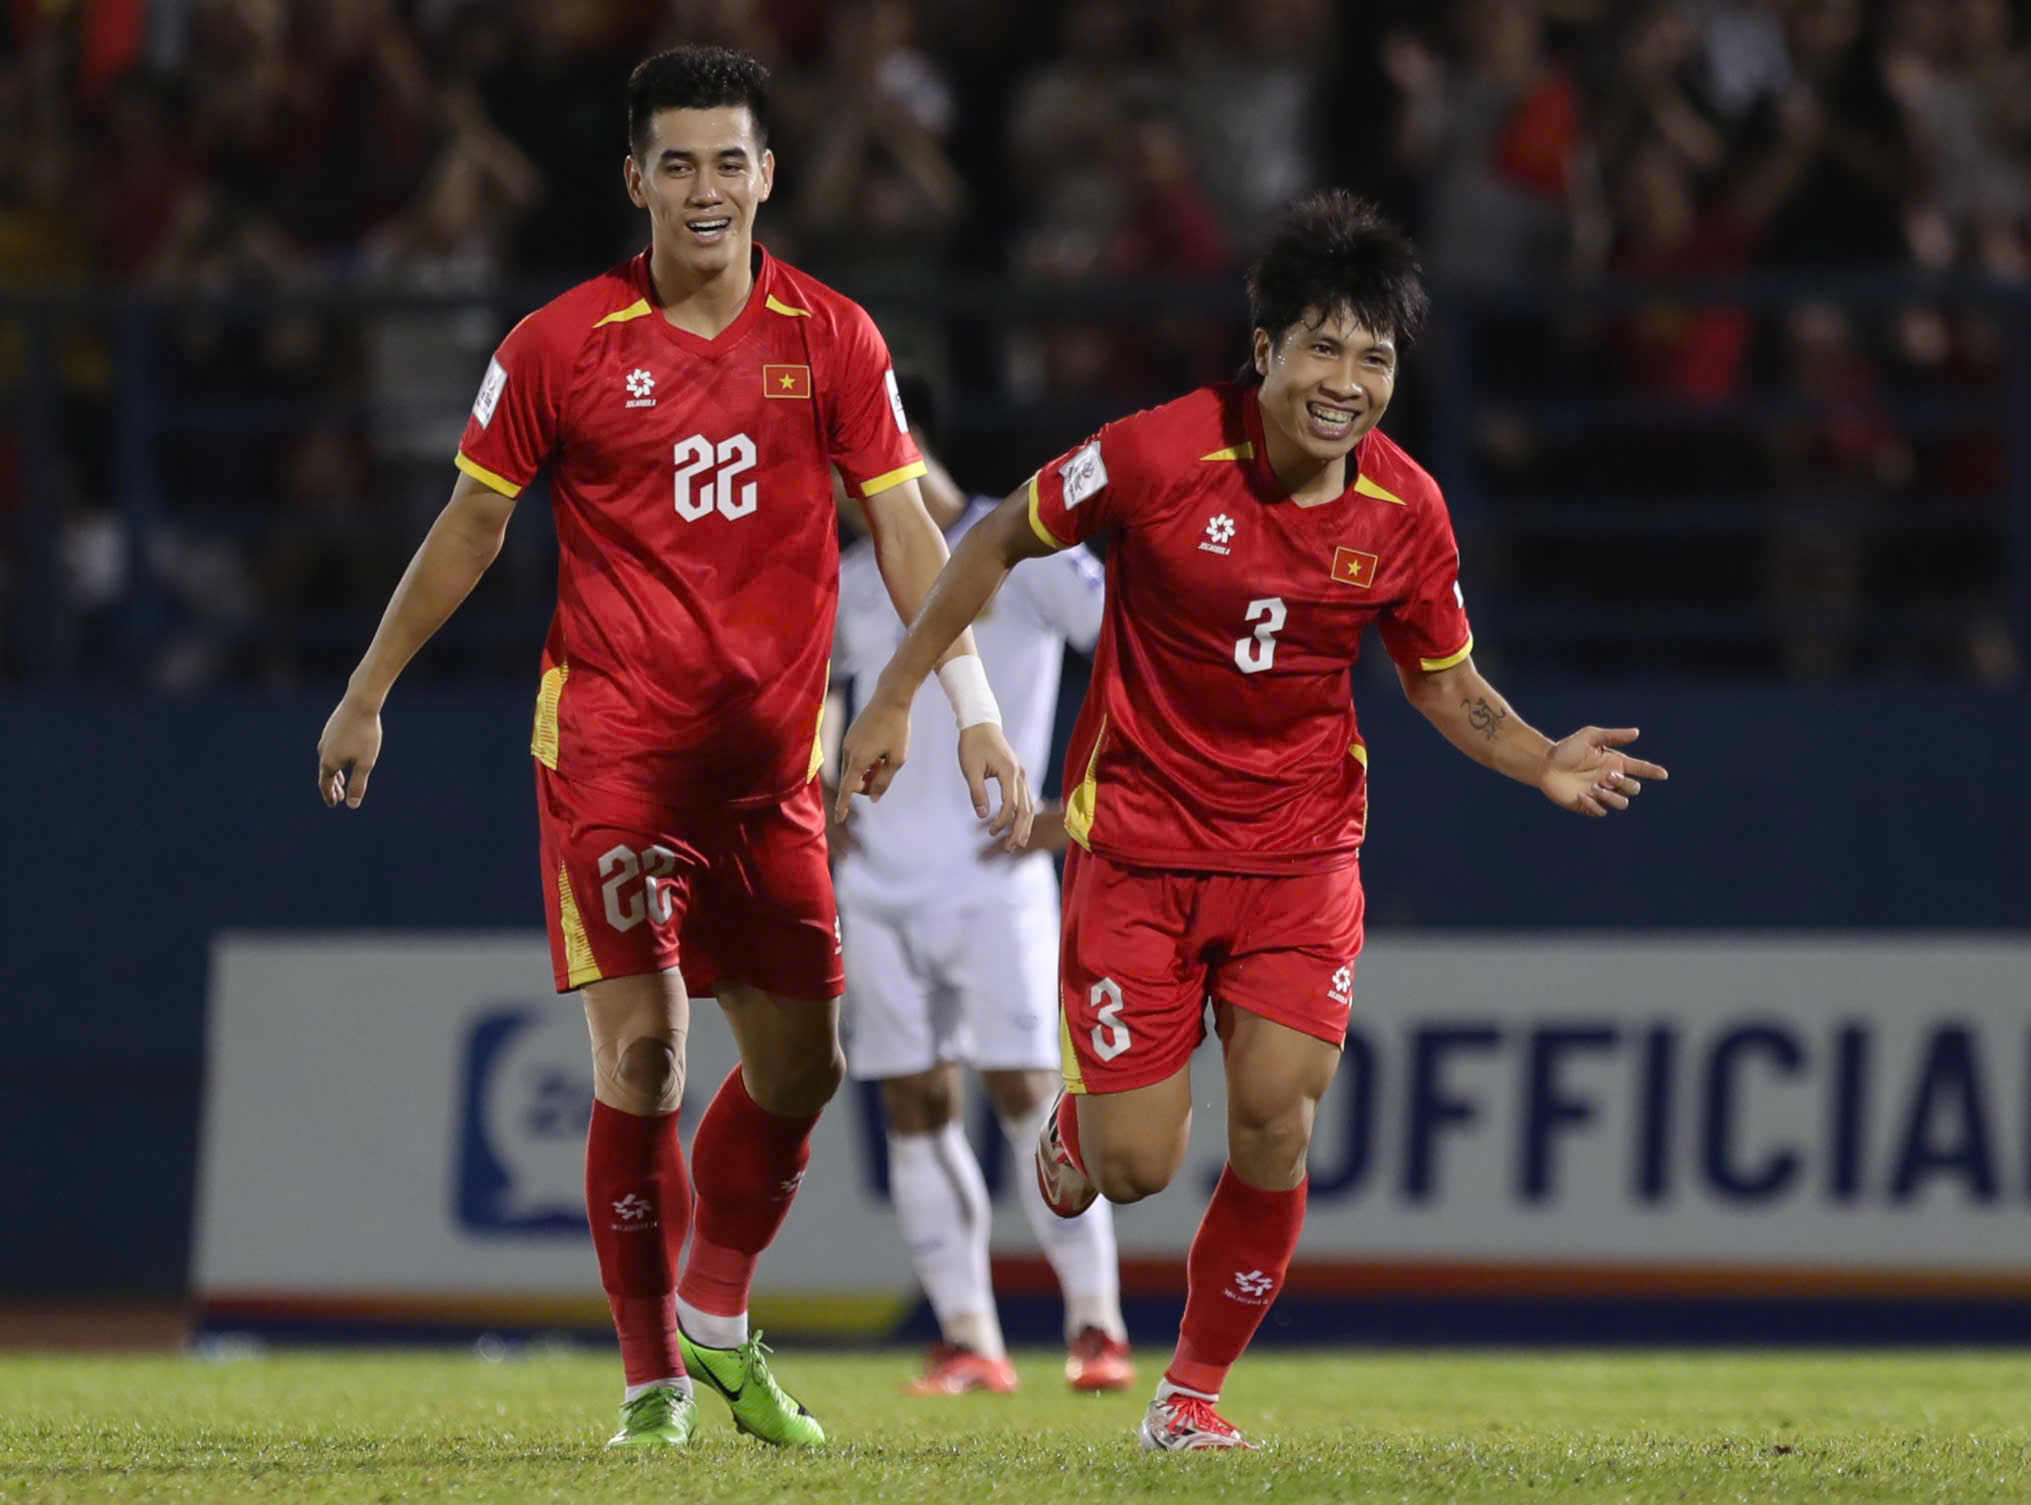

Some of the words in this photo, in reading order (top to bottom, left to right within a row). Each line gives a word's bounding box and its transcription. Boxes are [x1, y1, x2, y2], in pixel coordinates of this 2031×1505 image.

[674, 432, 757, 523] 22
[1234, 597, 1288, 674] 3
[597, 843, 676, 933] 22
[1090, 976, 1132, 1062] 3
[1306, 1018, 2031, 1206] OFFICIA
